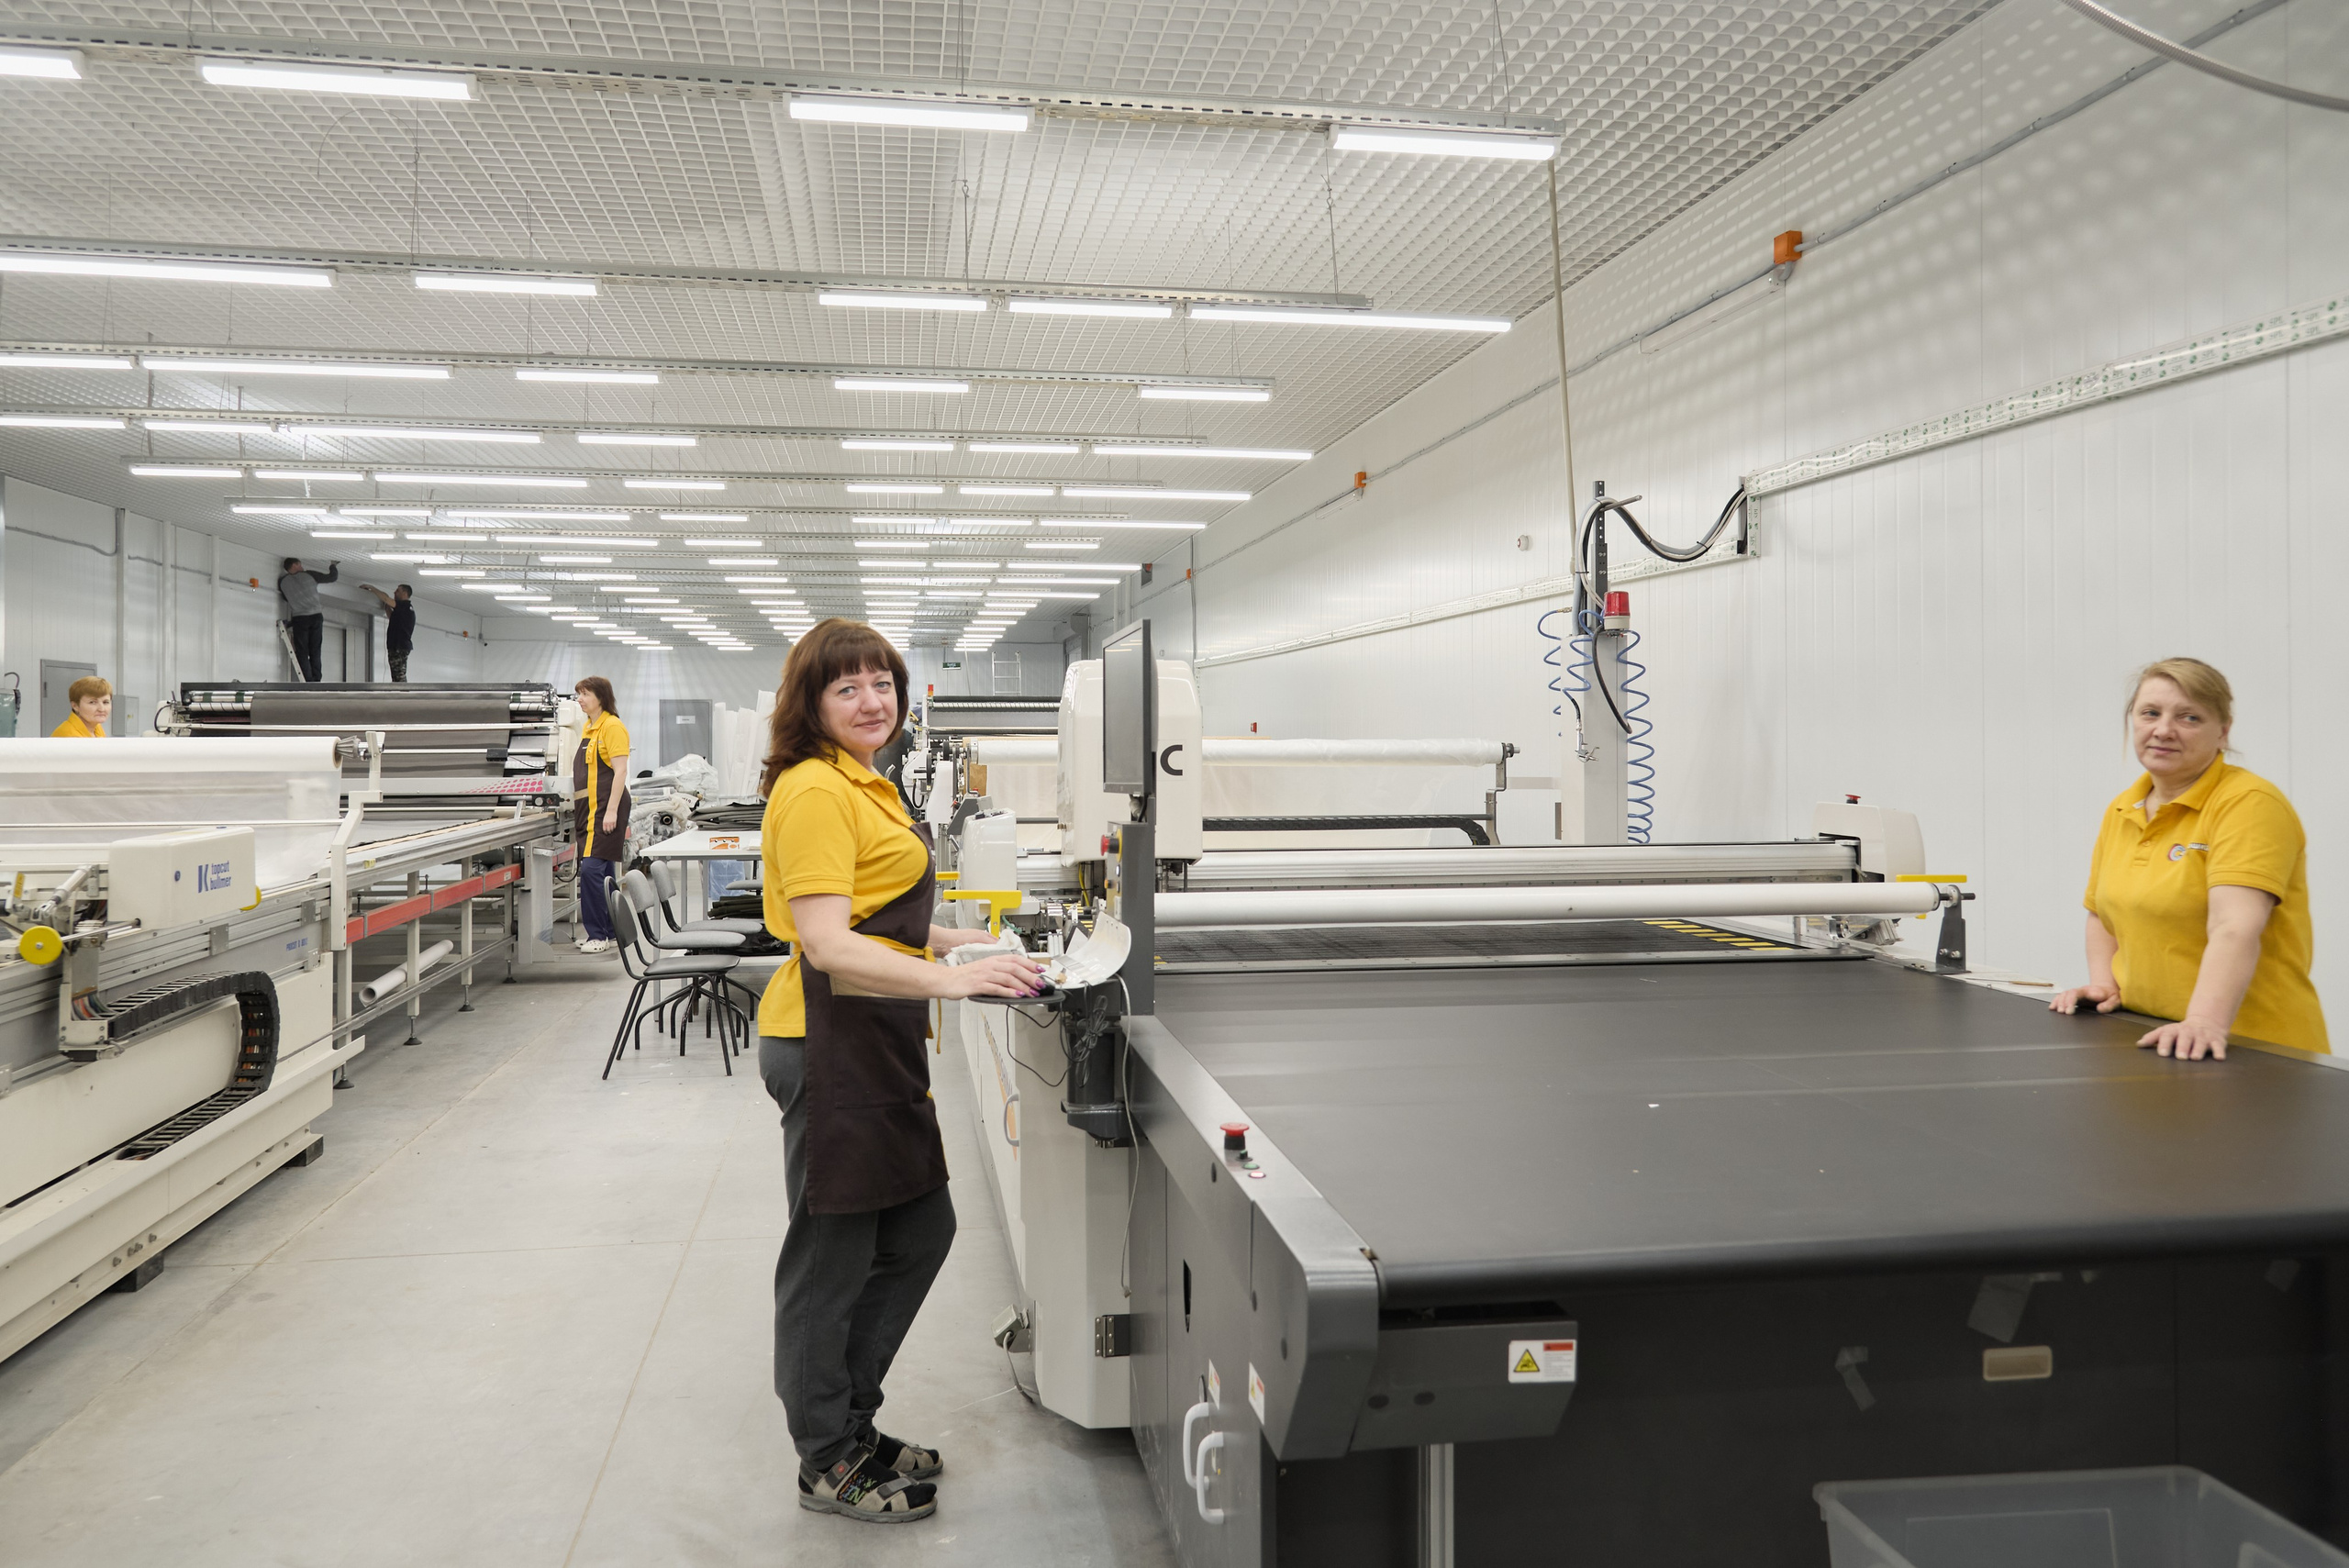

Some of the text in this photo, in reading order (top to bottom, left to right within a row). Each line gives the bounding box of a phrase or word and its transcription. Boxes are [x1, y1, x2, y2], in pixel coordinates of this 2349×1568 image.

[2043, 385, 2053, 394] SPL
[211, 861, 229, 877] topcut
[210, 876, 231, 890] bullmer
